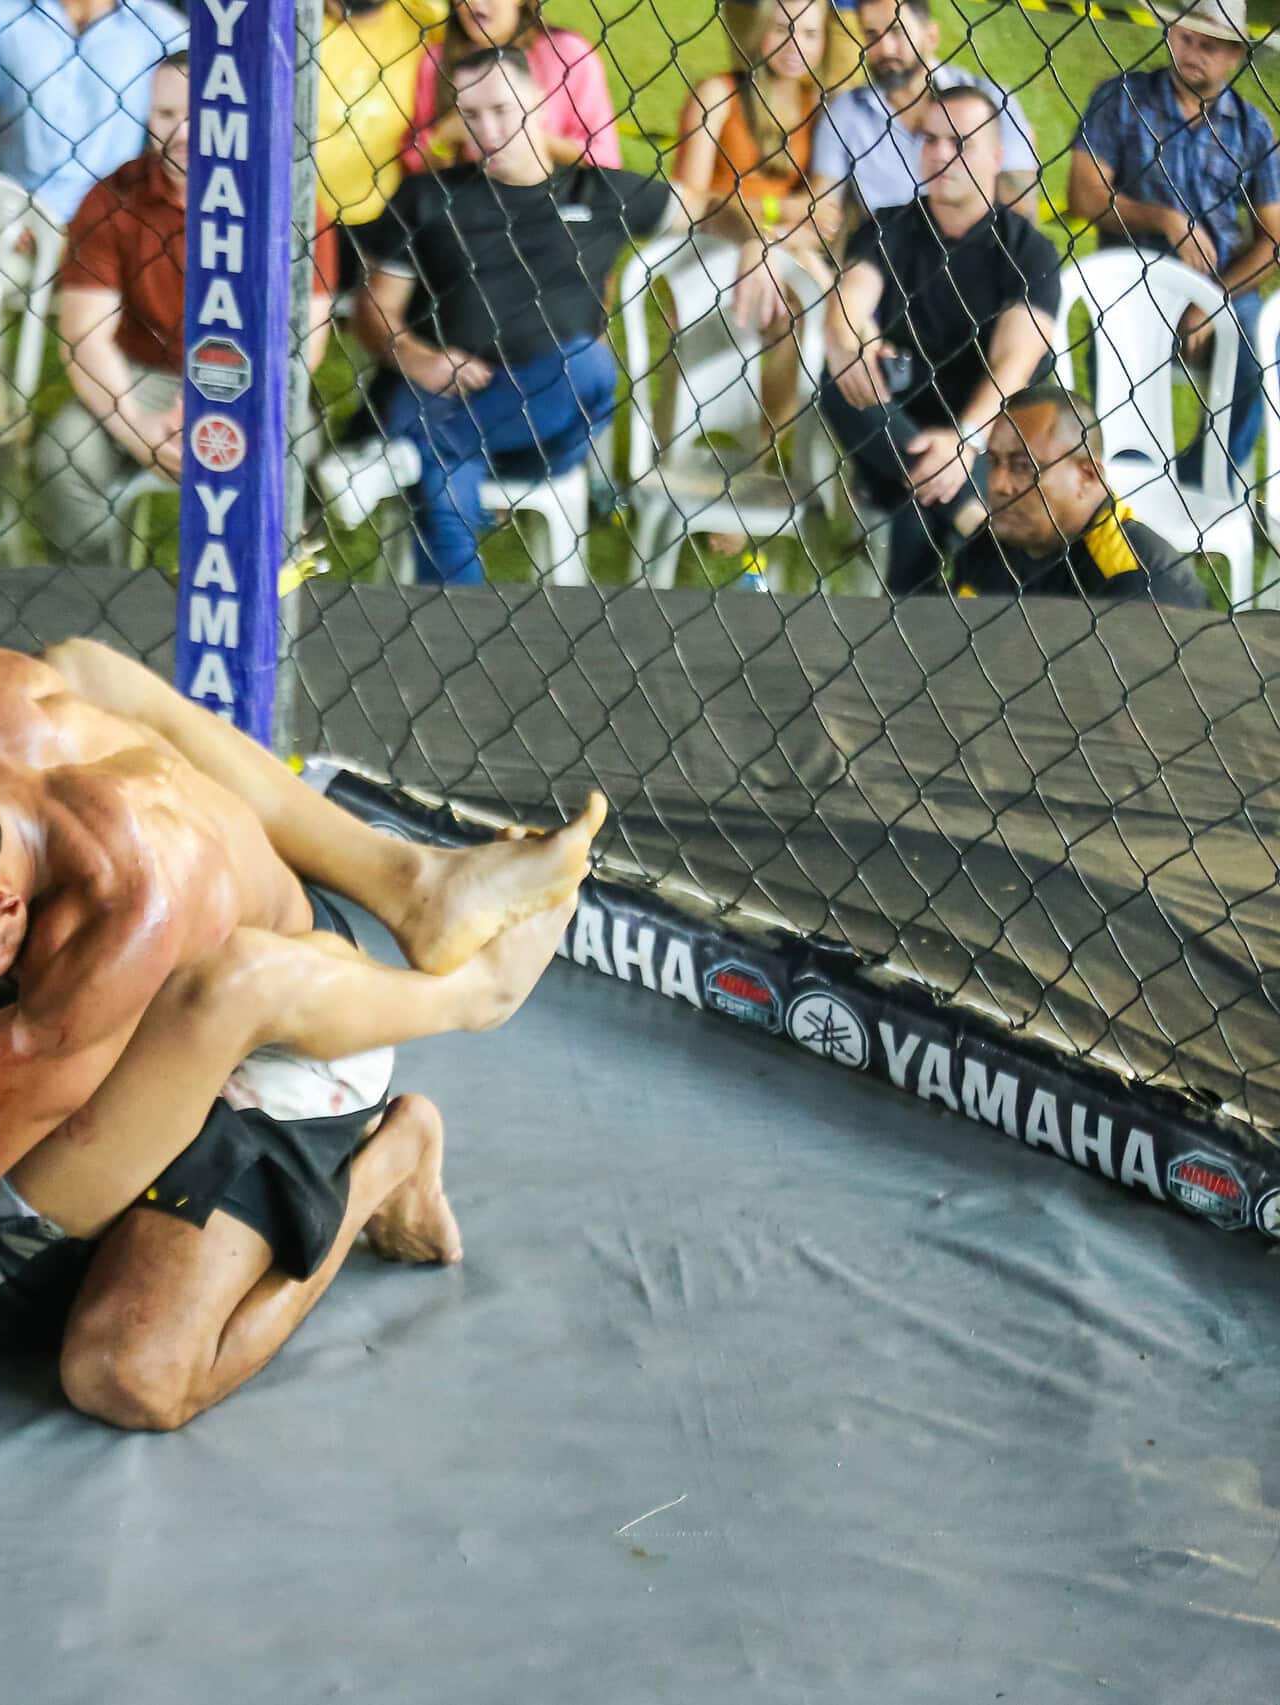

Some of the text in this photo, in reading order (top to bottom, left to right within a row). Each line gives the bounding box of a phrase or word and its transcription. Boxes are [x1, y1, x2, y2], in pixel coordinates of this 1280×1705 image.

[197, 0, 249, 330] YAMAHA
[189, 484, 240, 725] YAMA
[556, 903, 703, 1009] AHA
[878, 1021, 1166, 1200] YAMAHA
